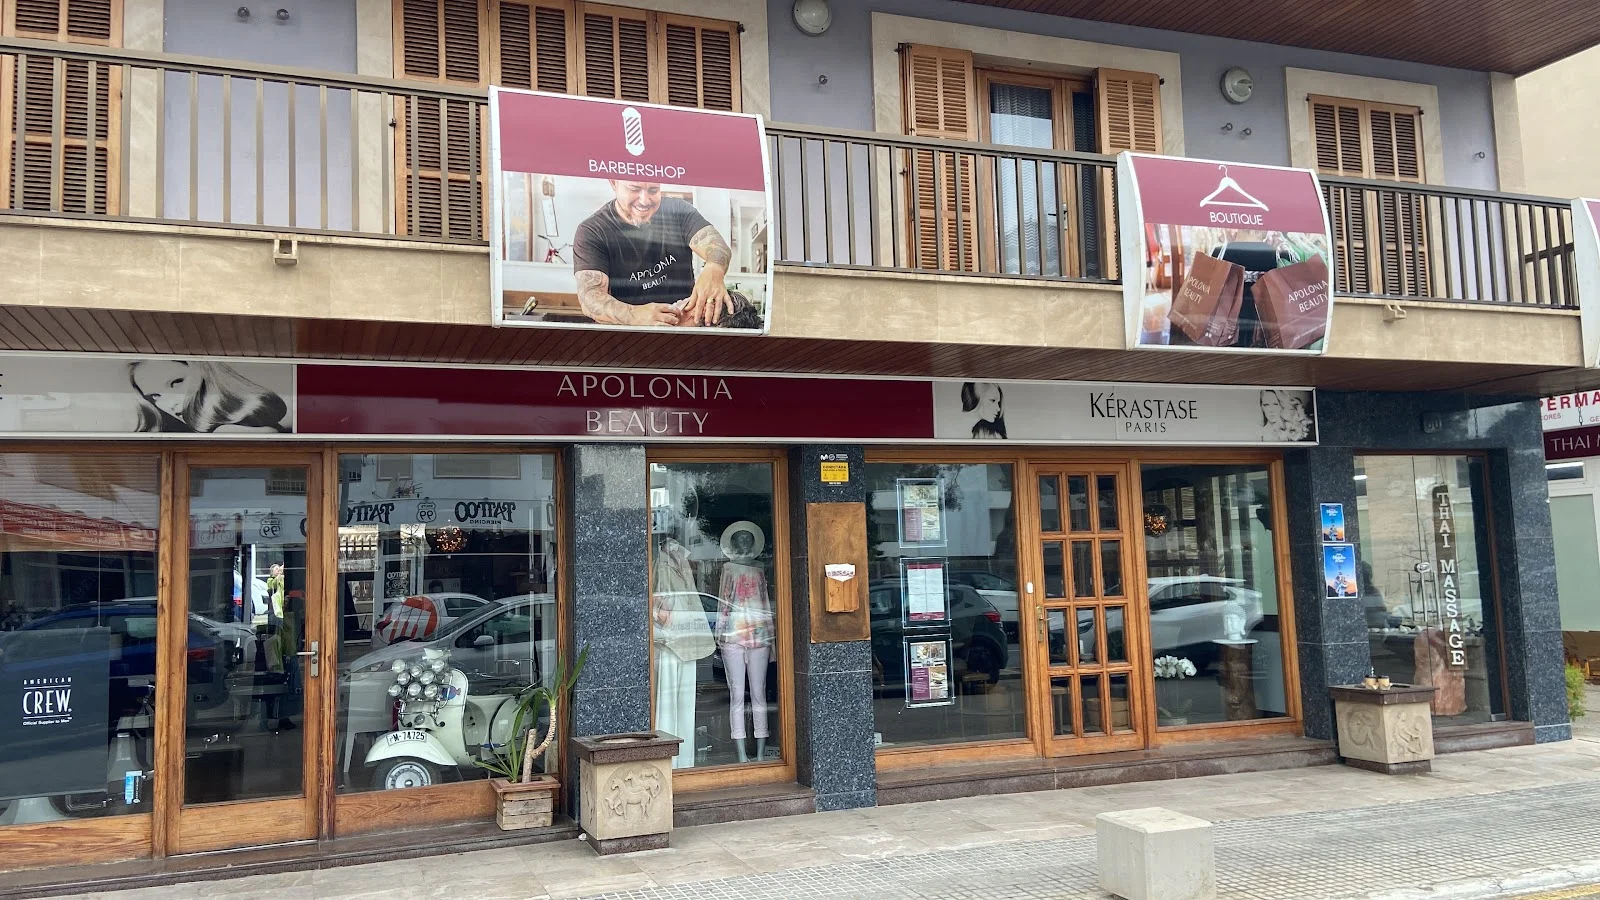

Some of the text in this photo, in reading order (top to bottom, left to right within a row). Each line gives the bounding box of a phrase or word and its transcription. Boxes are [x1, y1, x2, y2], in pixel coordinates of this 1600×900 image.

[588, 159, 686, 179] BARBERSHOP
[1209, 211, 1264, 226] BOUTIQUE
[629, 254, 677, 282] APOLONIA
[642, 274, 668, 290] BEAUTY
[1288, 279, 1329, 304] APOLONIA
[1298, 291, 1329, 313] BEAUTY
[556, 374, 733, 400] APOLONIA
[1090, 392, 1198, 420] KÉRASTASE
[586, 410, 709, 434] BEAUTY
[1125, 421, 1168, 433] PARIS
[1550, 434, 1591, 452] THAI
[1436, 491, 1451, 549] THAI
[1440, 558, 1465, 666] MASSAGE
[23, 677, 72, 685] AMERICAN
